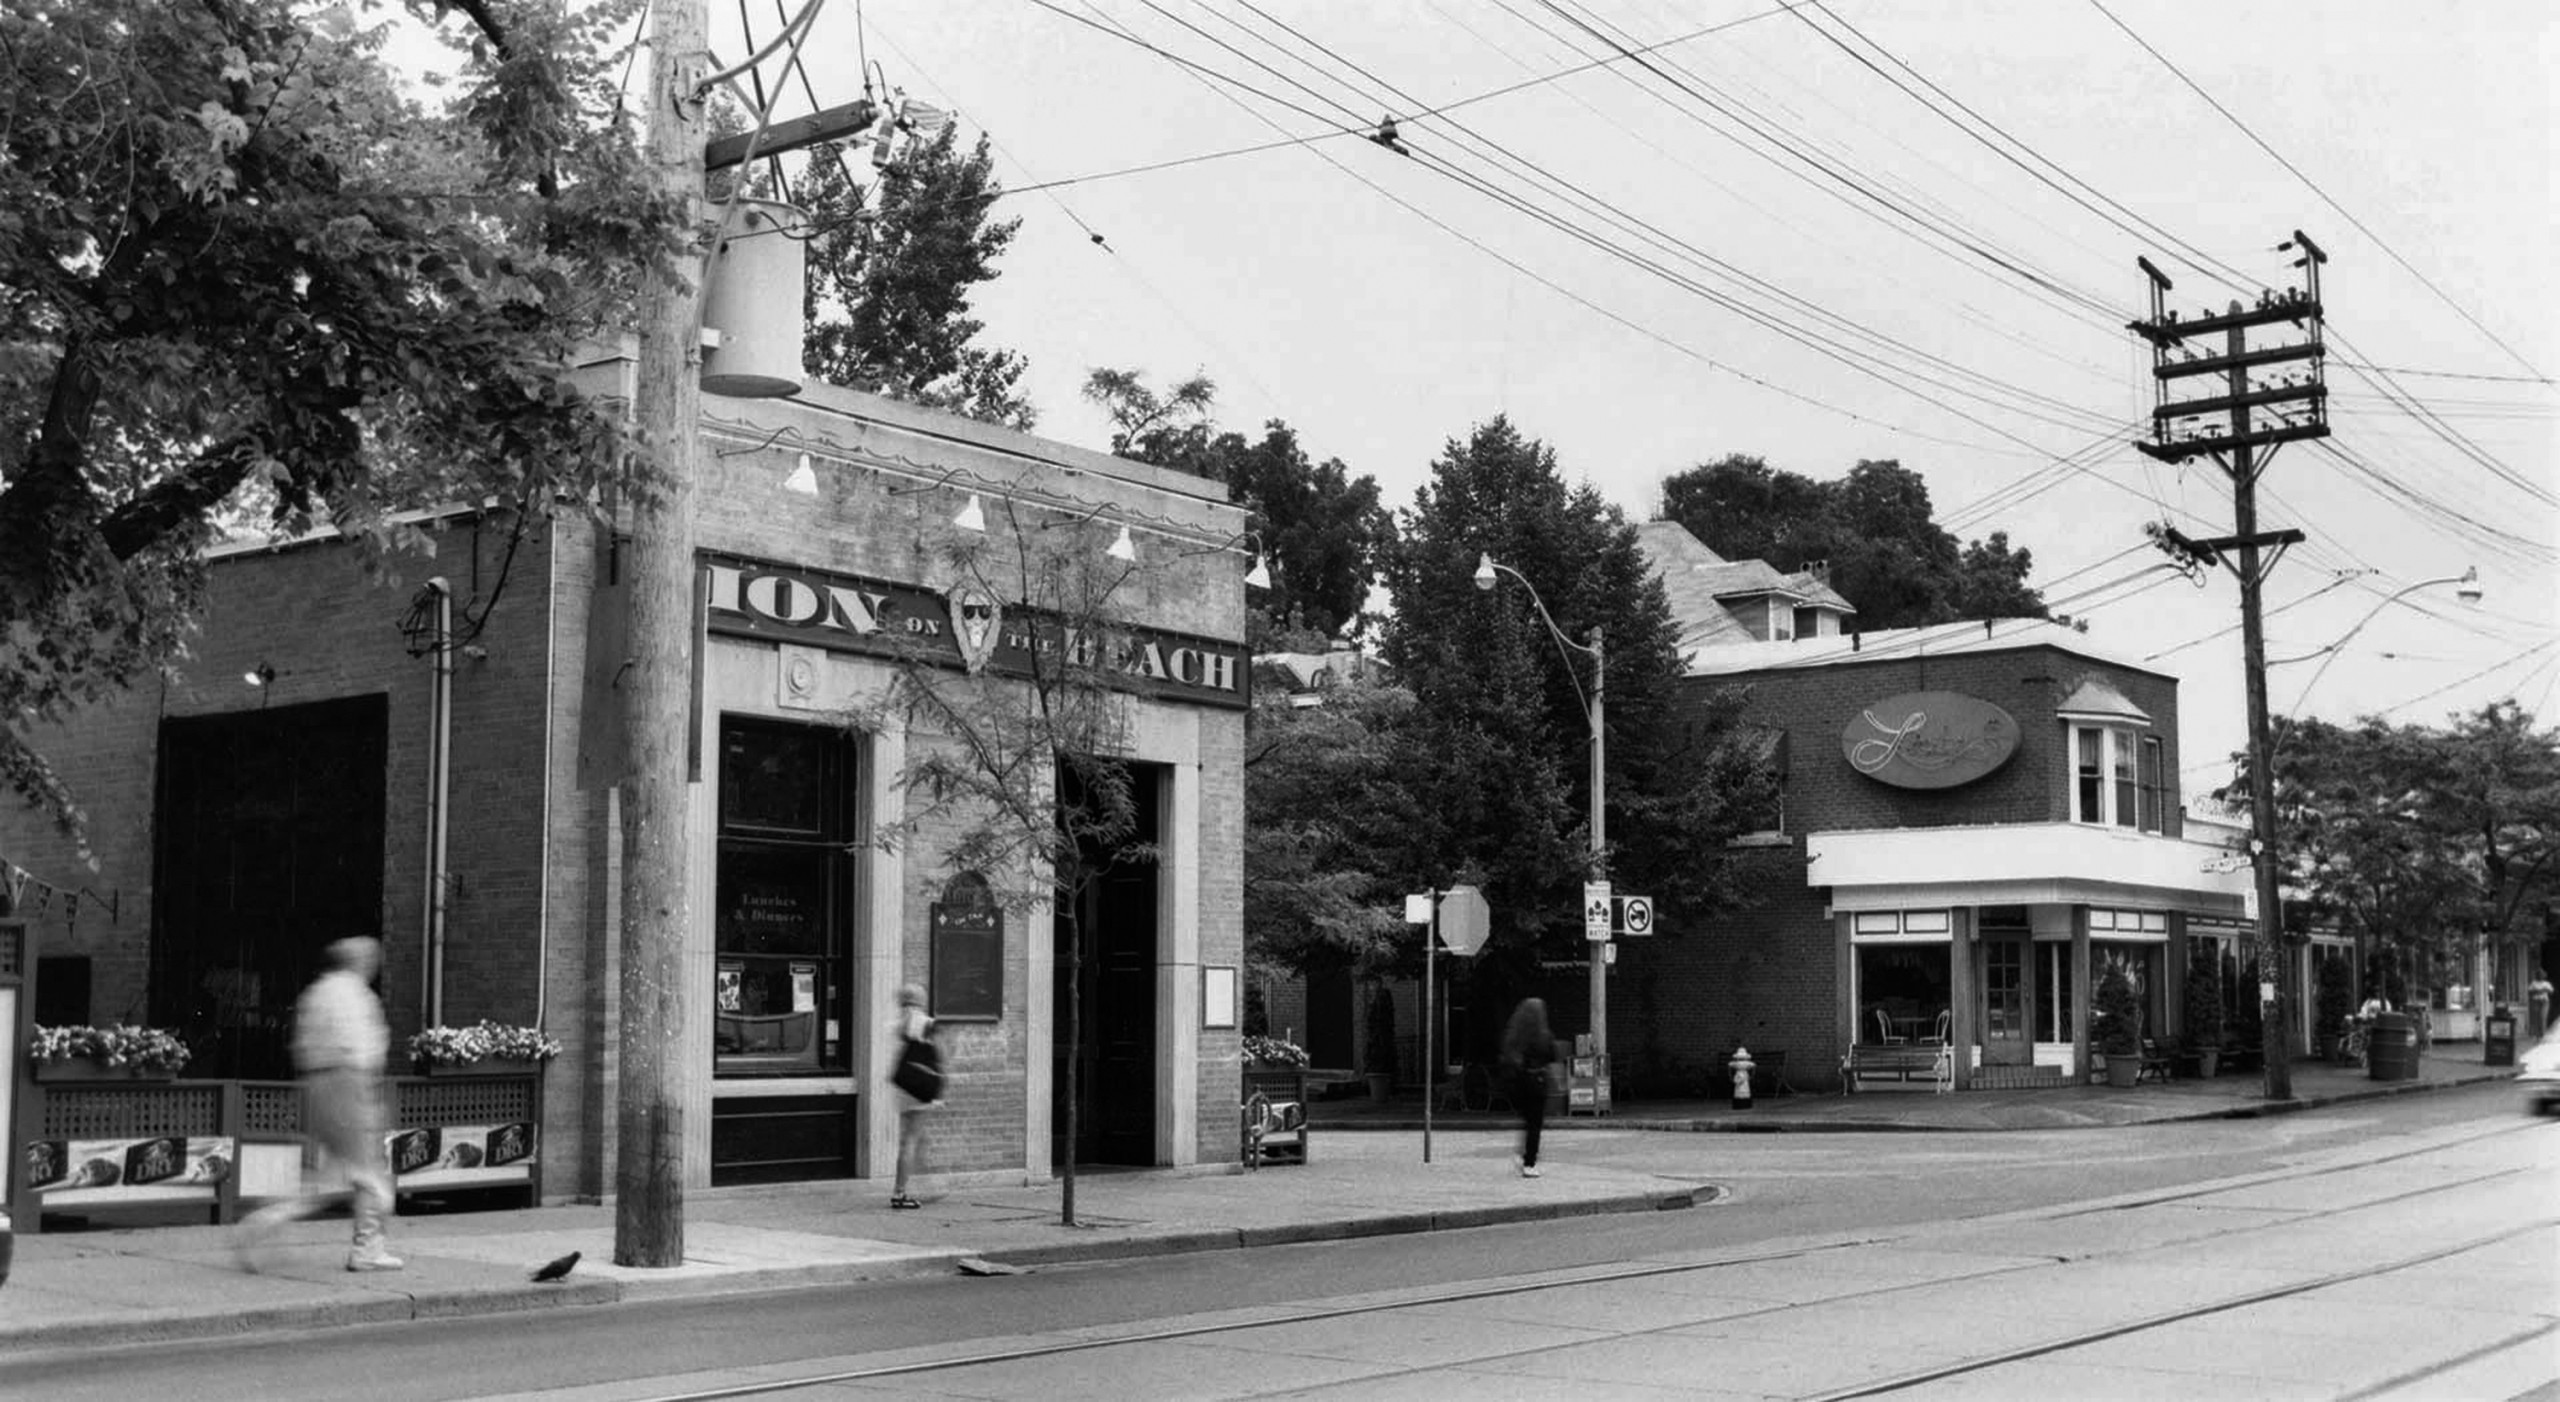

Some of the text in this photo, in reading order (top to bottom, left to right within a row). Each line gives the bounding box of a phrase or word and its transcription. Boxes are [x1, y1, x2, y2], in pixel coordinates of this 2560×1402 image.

[707, 563, 888, 635] ION
[906, 616, 942, 636] ON
[741, 893, 798, 907] Lunches
[733, 909, 745, 921] &
[135, 1154, 175, 1181] DRY
